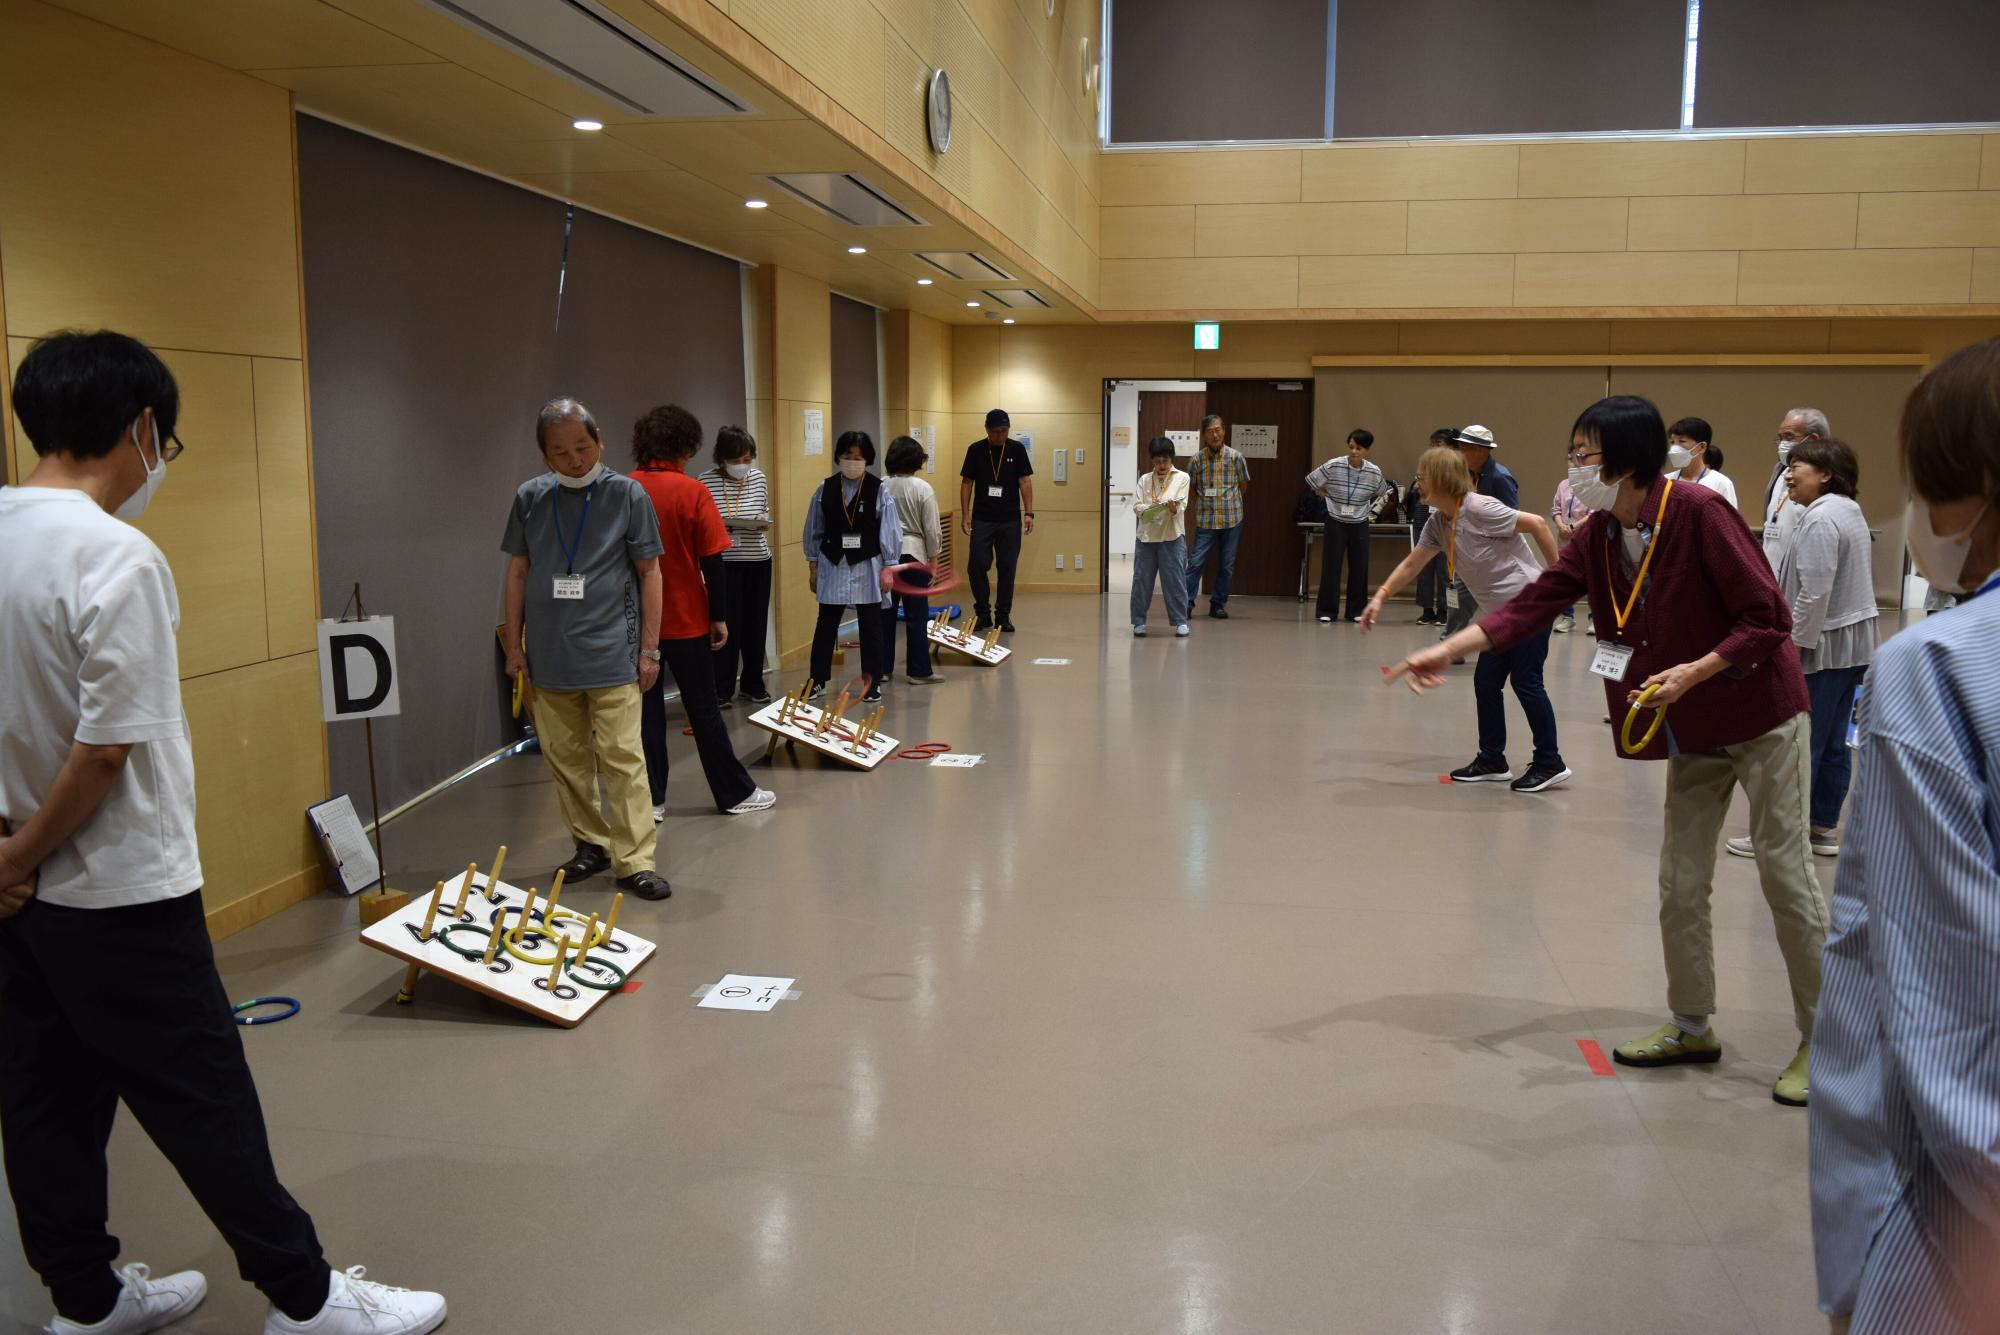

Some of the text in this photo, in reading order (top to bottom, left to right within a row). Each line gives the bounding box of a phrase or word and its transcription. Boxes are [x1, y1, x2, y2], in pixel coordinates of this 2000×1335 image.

[329, 633, 392, 714] D
[402, 884, 509, 945] 4 9 2
[461, 949, 515, 975] 3
[531, 976, 581, 1001] 8
